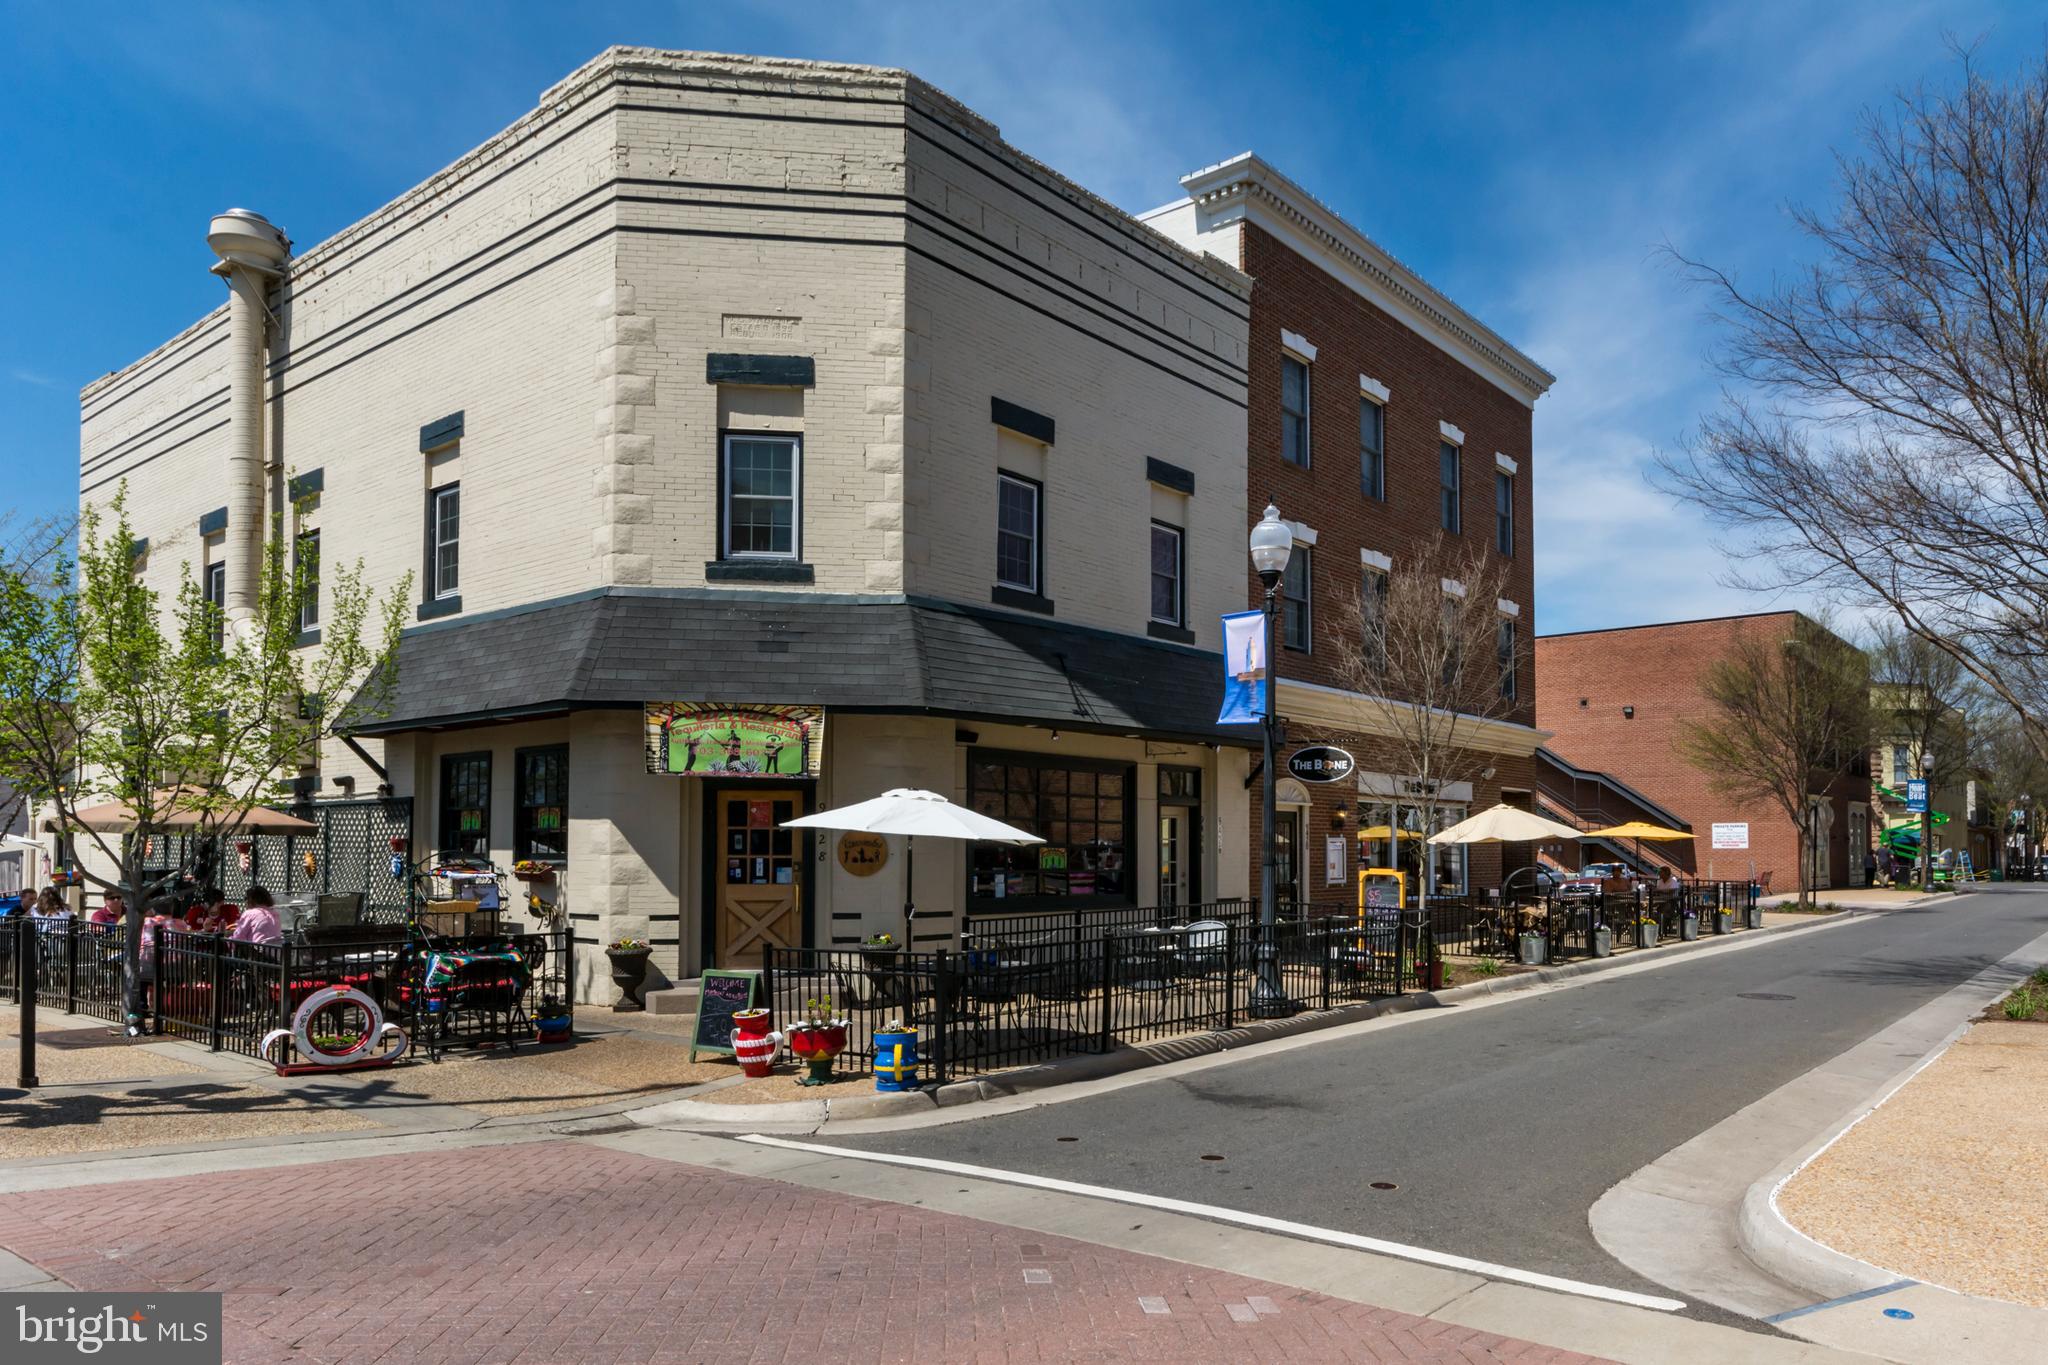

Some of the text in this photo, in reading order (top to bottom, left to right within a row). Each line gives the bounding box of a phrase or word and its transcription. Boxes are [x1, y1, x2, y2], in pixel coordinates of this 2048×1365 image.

[729, 721, 738, 730] &
[742, 721, 803, 740] Restaurant
[1293, 759, 1312, 771] THE
[1908, 783, 1926, 792] Heart
[1908, 791, 1926, 801] Beat
